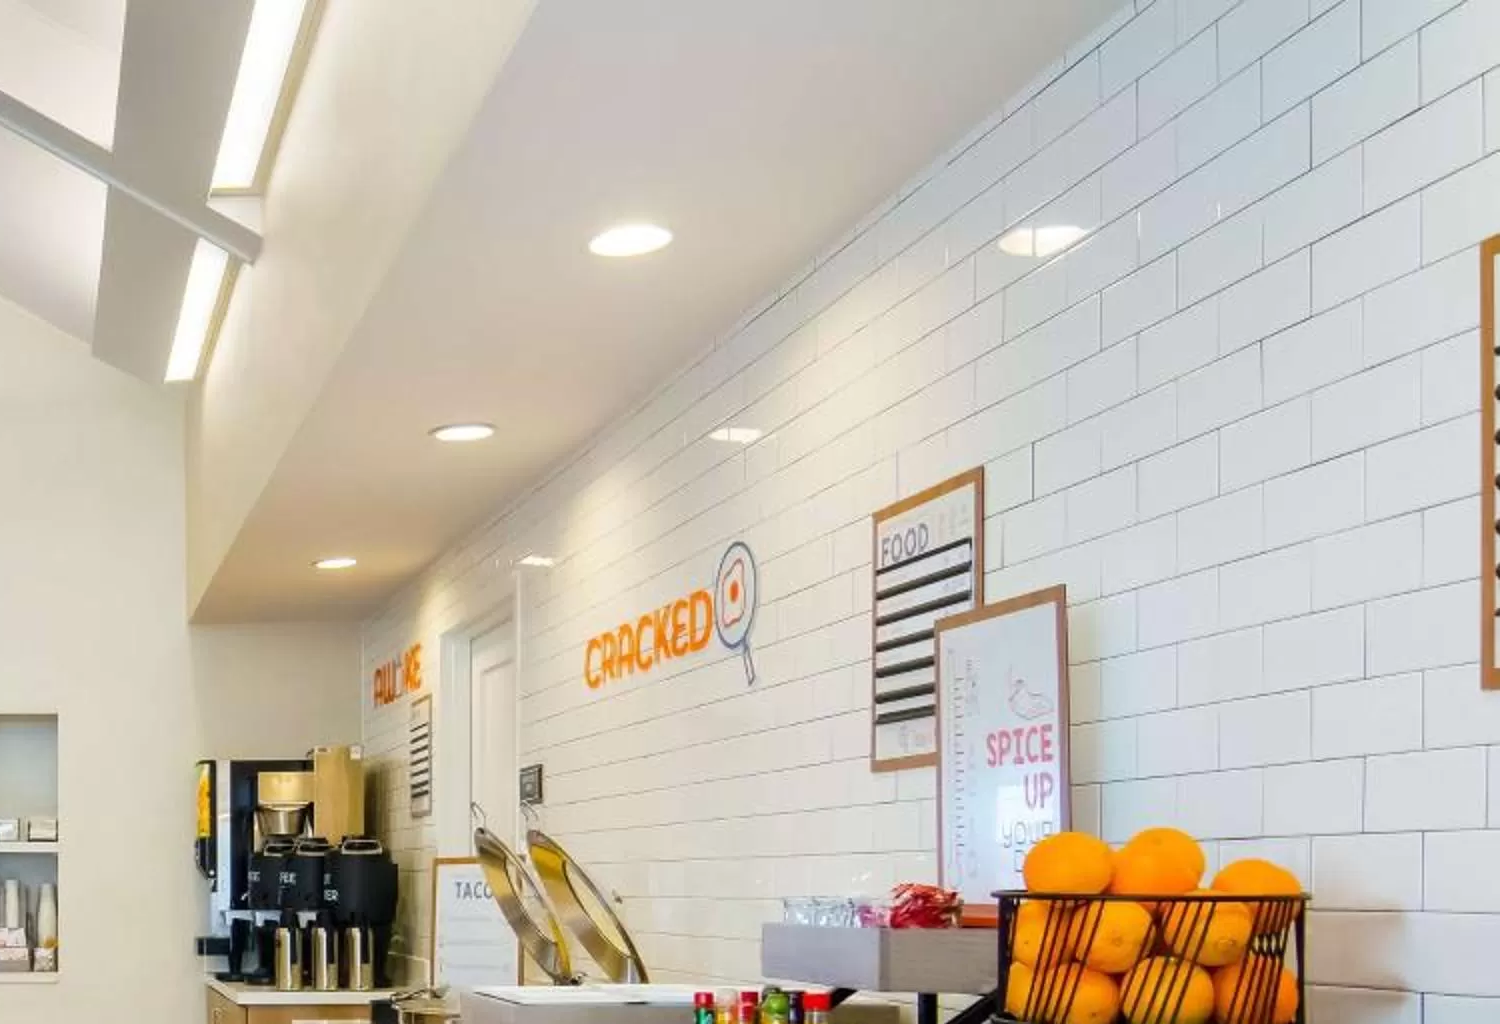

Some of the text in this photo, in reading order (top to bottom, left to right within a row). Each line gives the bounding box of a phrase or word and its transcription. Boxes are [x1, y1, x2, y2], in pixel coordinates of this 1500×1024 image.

[880, 523, 929, 566] FOOD
[584, 588, 714, 690] CRACKED
[986, 723, 1054, 768] SPICE
[1023, 772, 1054, 809] UP
